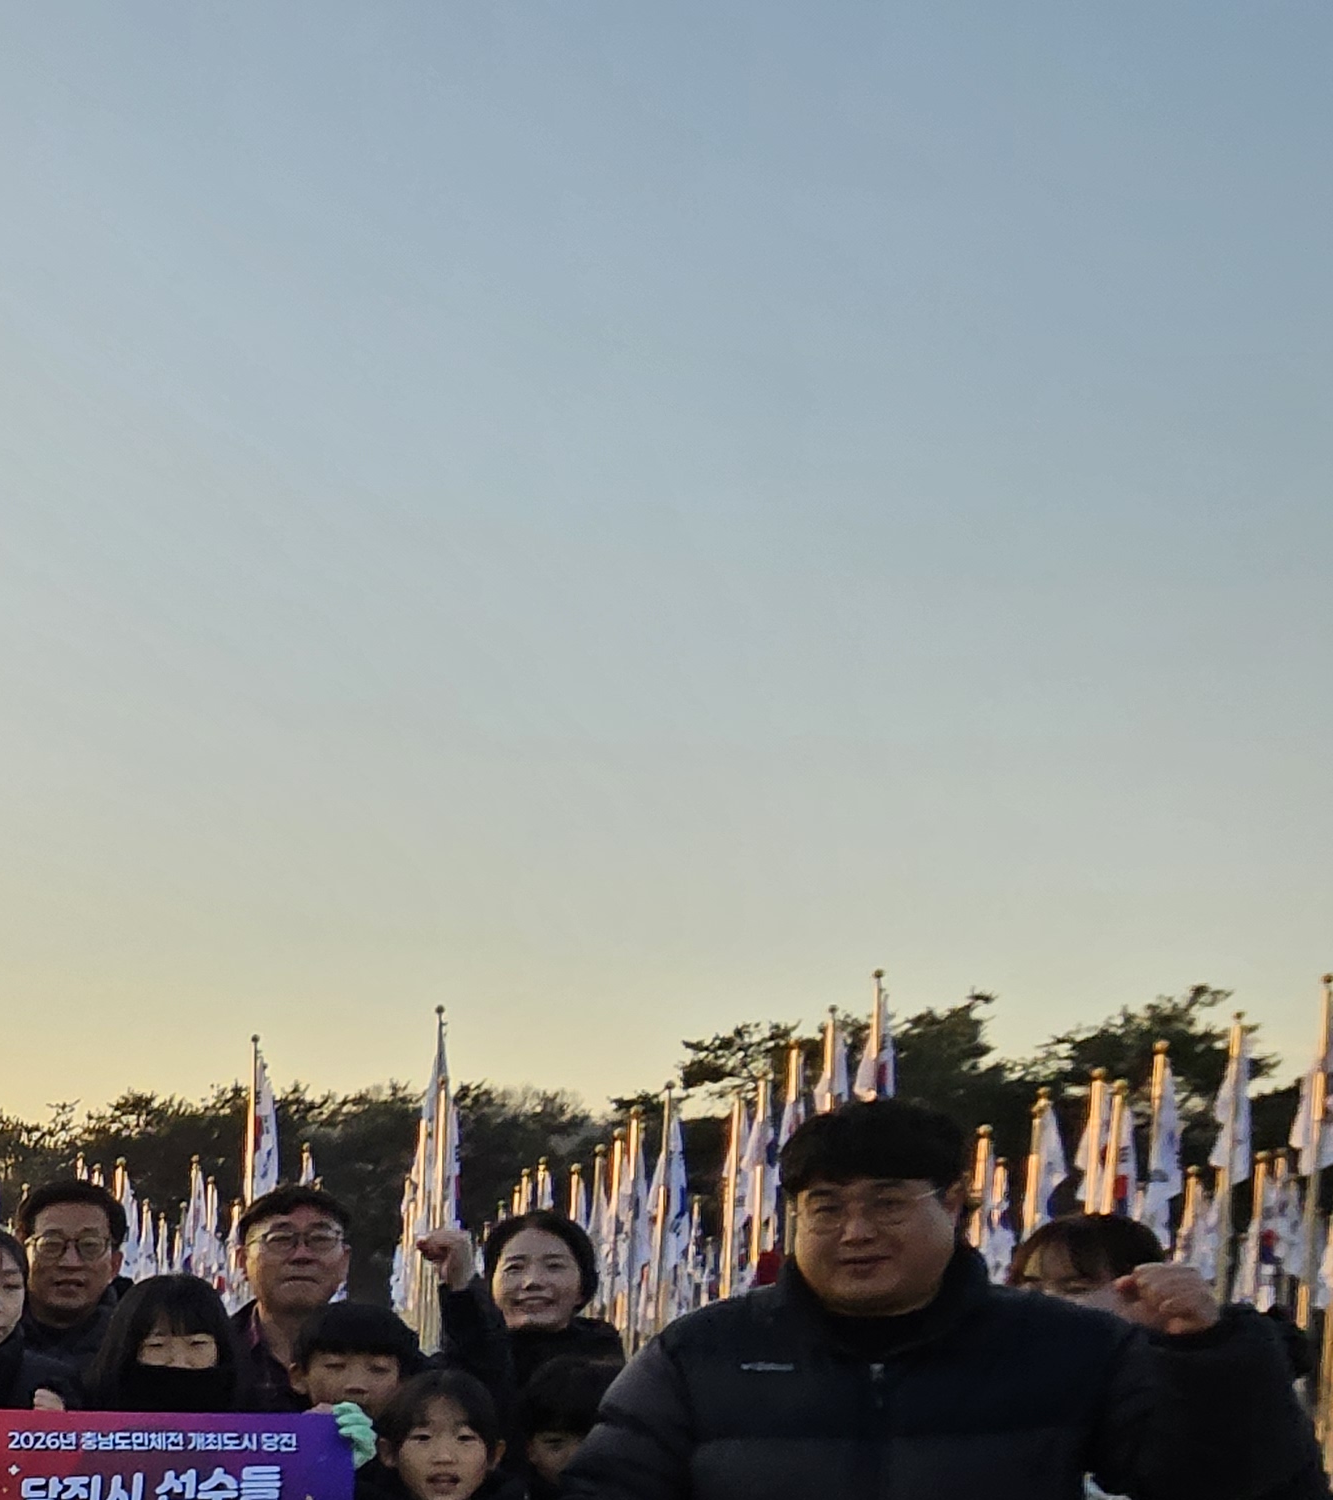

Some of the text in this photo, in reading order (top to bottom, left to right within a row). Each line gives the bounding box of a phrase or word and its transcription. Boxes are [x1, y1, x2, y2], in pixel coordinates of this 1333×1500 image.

[7, 1431, 297, 1452] 2026년 충남도민체전 개최도시 당진
